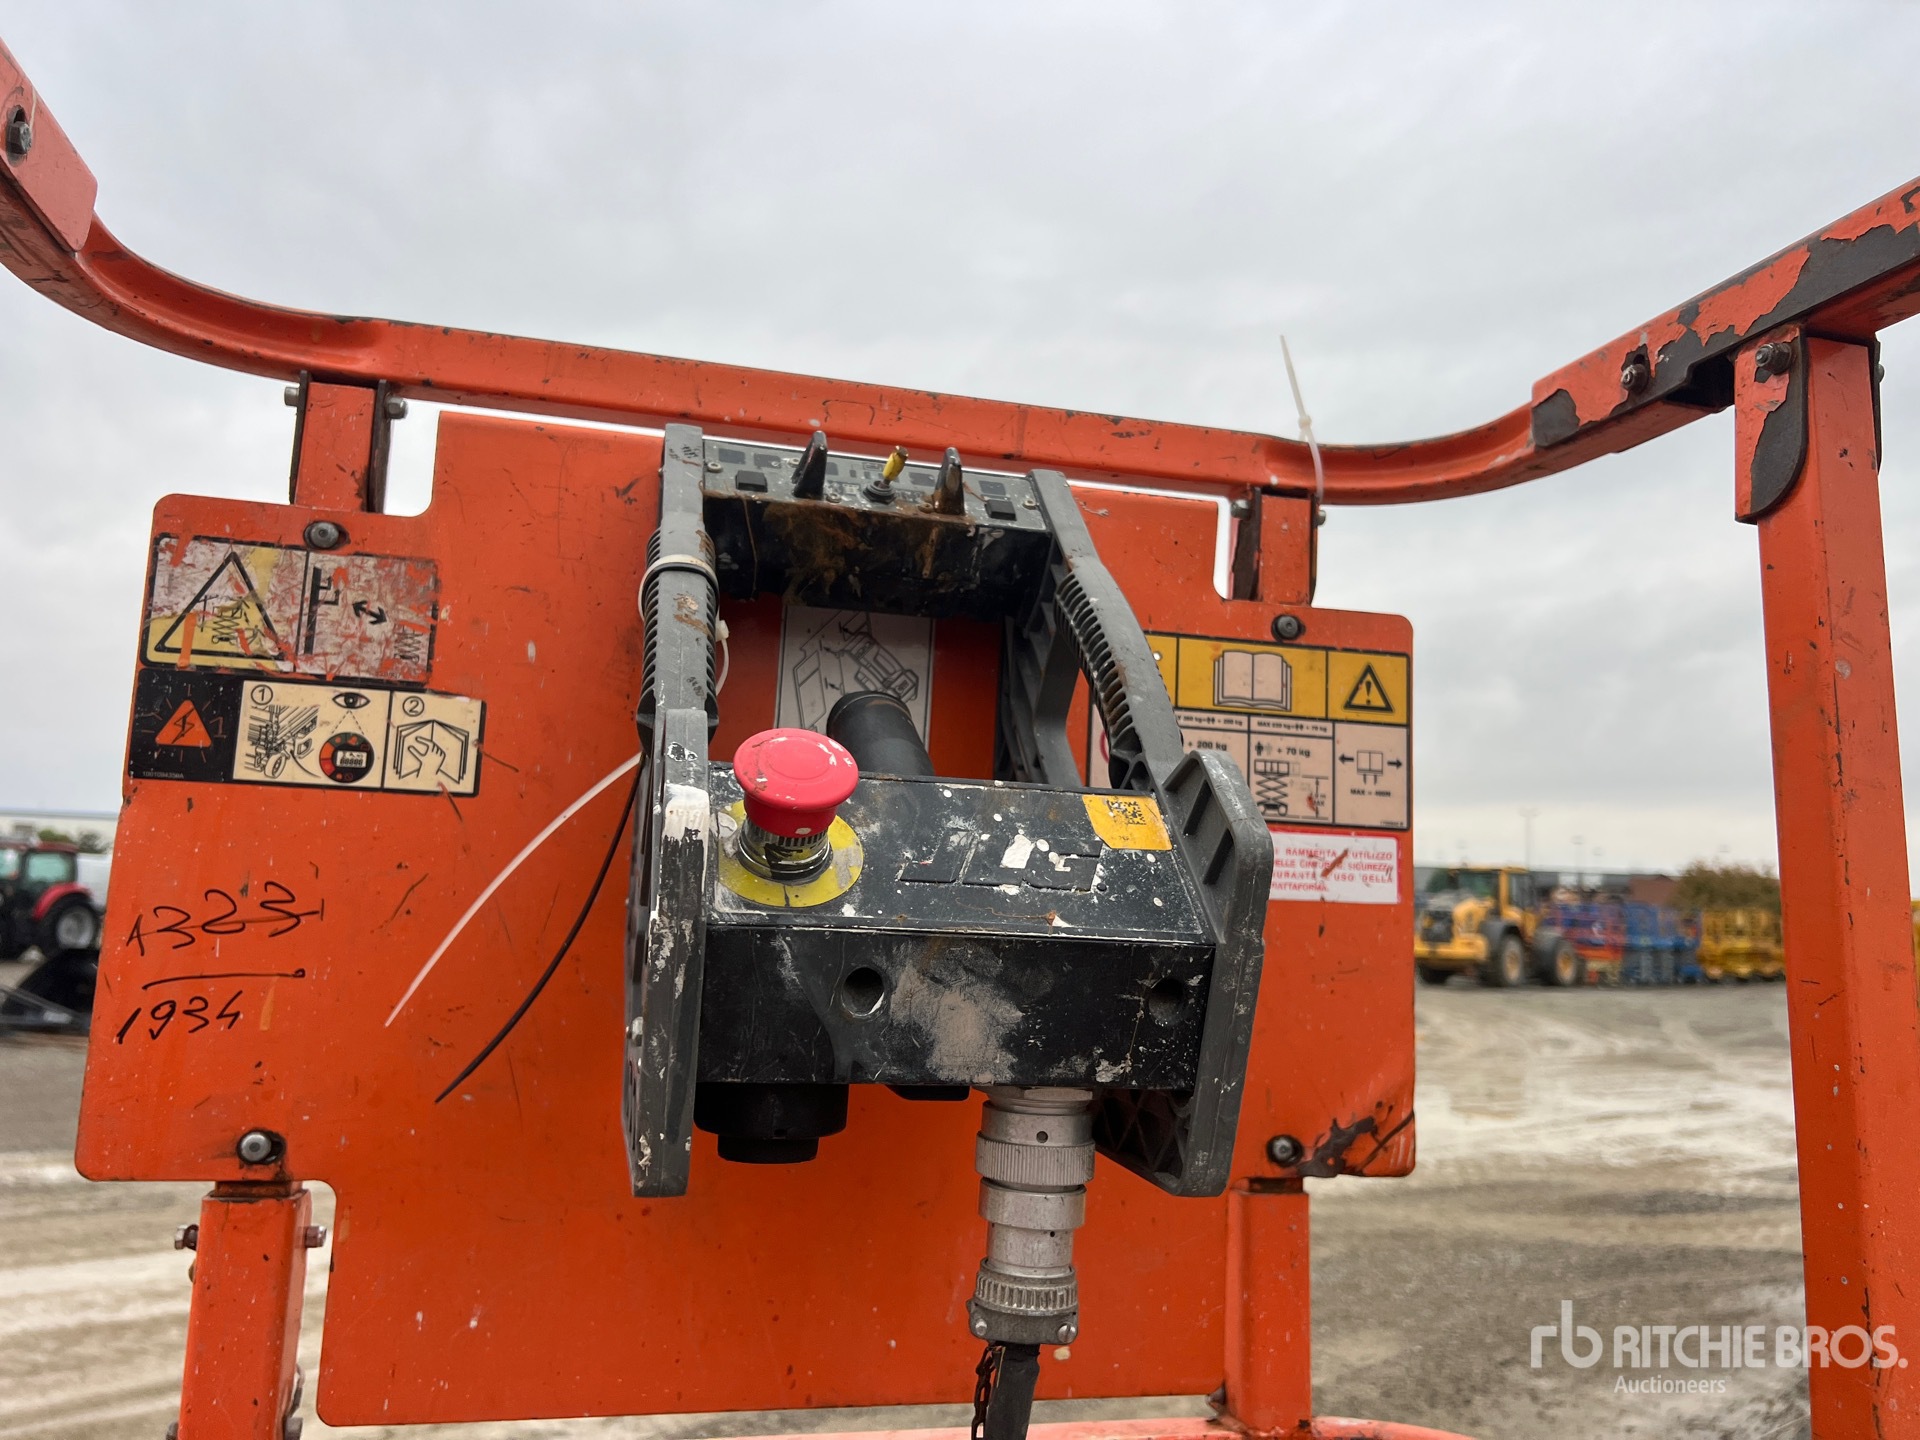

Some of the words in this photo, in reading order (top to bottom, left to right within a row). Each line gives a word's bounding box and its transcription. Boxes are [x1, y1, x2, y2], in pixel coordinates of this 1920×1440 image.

[1197, 741, 1213, 750] 200
[1215, 742, 1228, 752] kg
[1286, 747, 1297, 756] 70
[1298, 749, 1311, 759] kg
[1350, 788, 1366, 796] MAX
[897, 828, 1105, 892] JLG
[1275, 859, 1296, 869] ELLE
[117, 991, 243, 1045] 1934
